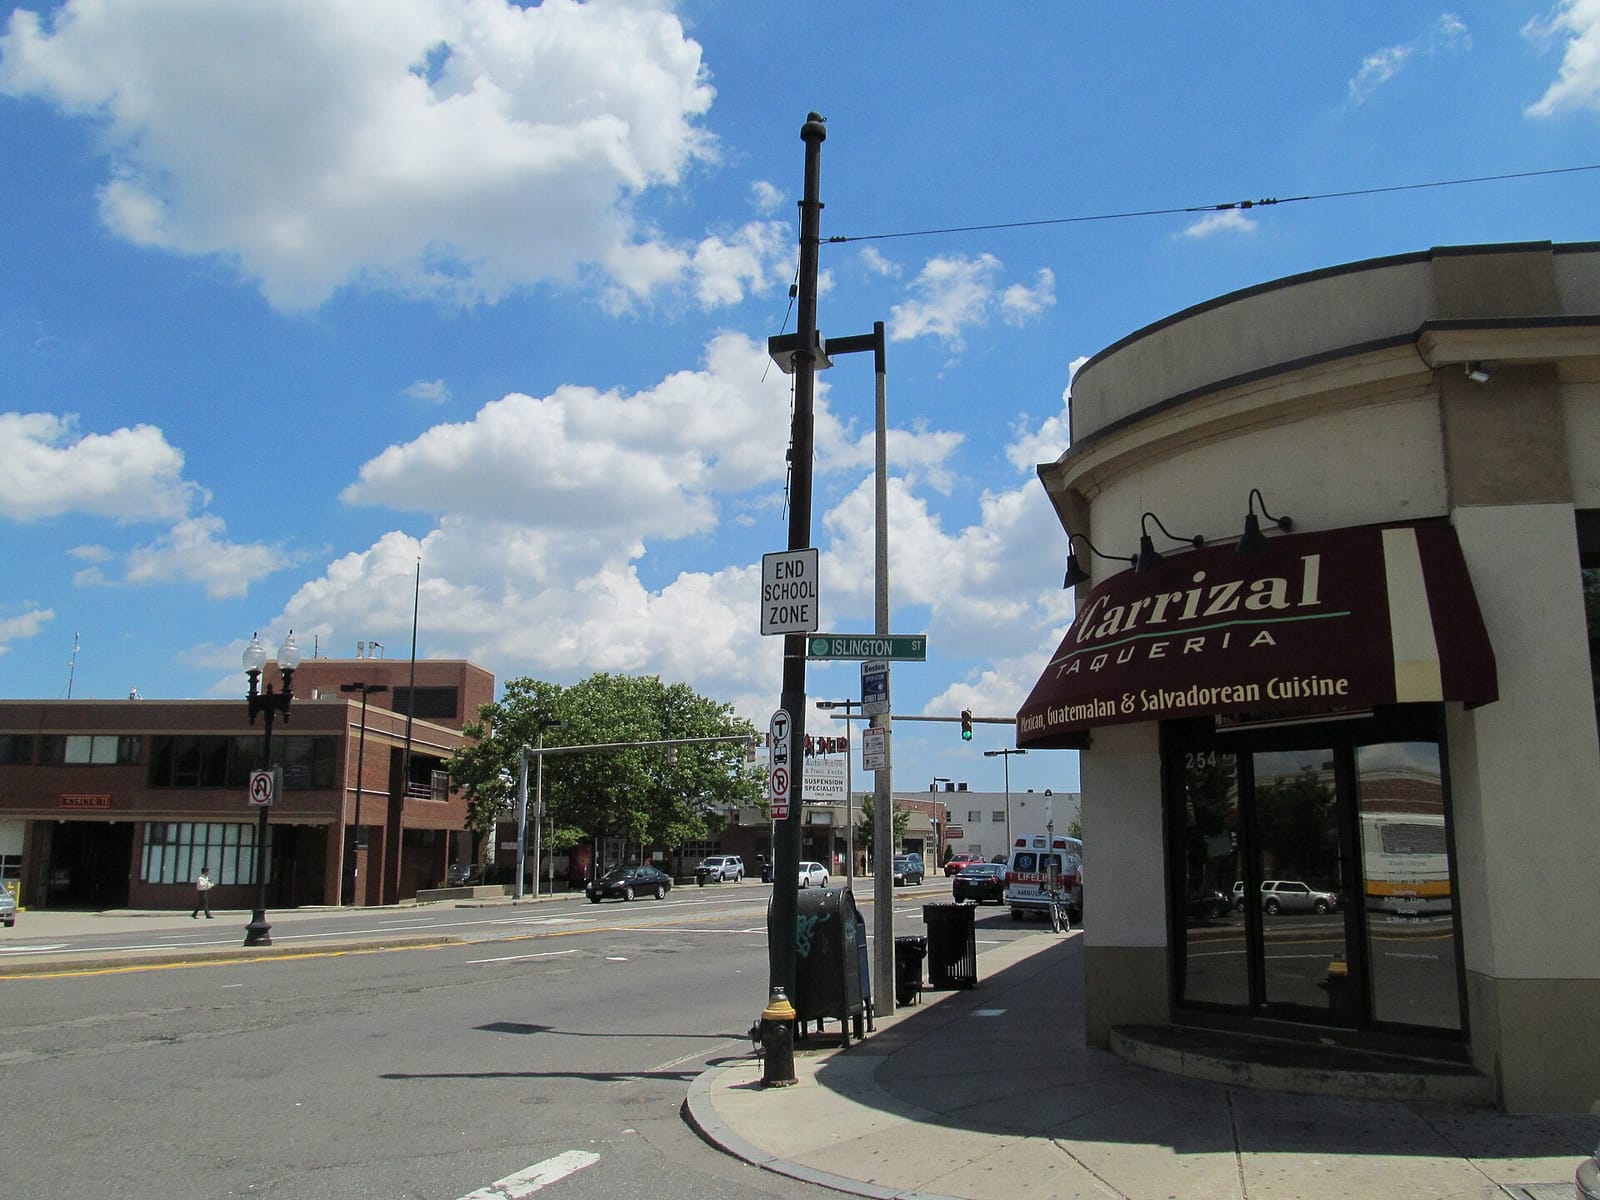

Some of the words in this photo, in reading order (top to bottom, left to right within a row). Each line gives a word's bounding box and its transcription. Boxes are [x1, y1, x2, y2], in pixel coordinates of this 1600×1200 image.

[775, 560, 804, 580] END
[764, 581, 815, 601] SCHOOL
[1076, 554, 1321, 644] Carrizal
[769, 604, 809, 625] ZONE
[831, 639, 893, 656] ISLINGTON
[911, 640, 922, 651] ST
[1056, 630, 1277, 679] TAQUERIA
[1020, 714, 1046, 733] Mexican,
[1047, 698, 1116, 726] Guatemalan
[1120, 692, 1136, 714] &
[1140, 681, 1261, 712] Salvadorean
[1266, 675, 1349, 699] Cuisine
[774, 719, 787, 738] T
[1185, 750, 1217, 769] 254
[804, 777, 843, 785] SUSPENSION
[1017, 872, 1048, 882] LIFELI
